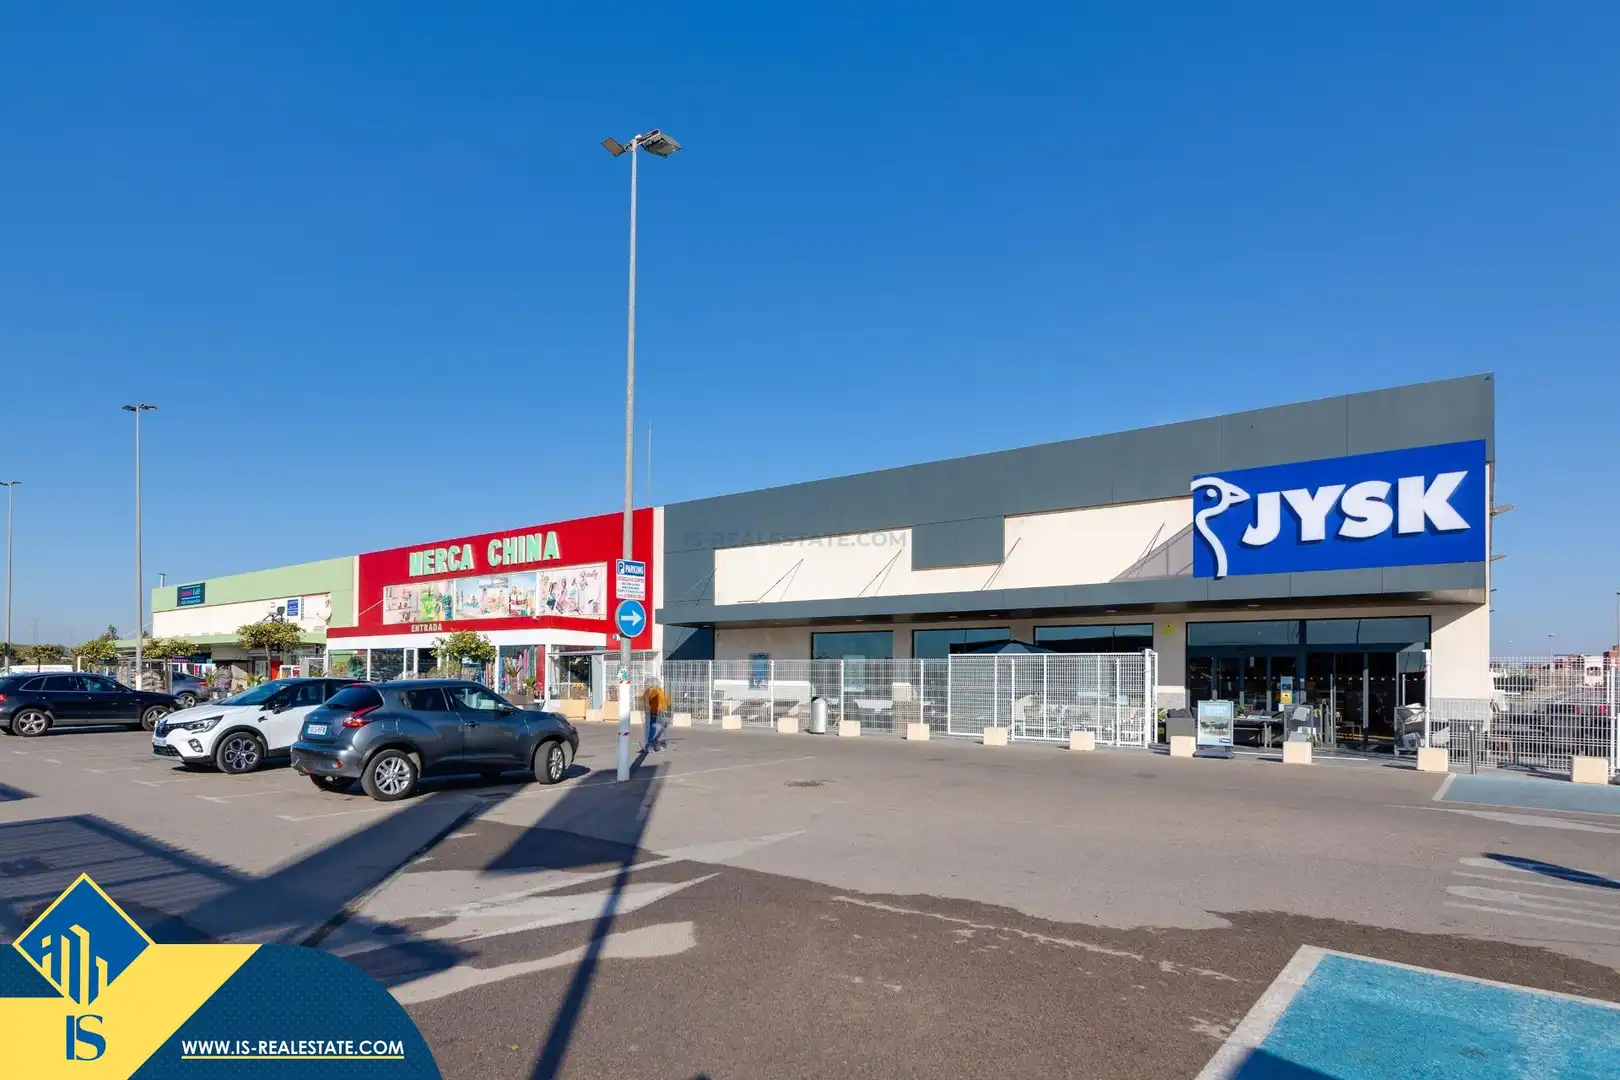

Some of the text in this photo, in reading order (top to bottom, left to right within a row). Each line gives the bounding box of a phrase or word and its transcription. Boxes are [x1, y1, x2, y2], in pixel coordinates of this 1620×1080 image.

[1241, 470, 1472, 546] JYSK
[487, 531, 561, 567] CHINA
[411, 622, 443, 632] ENTRADA
